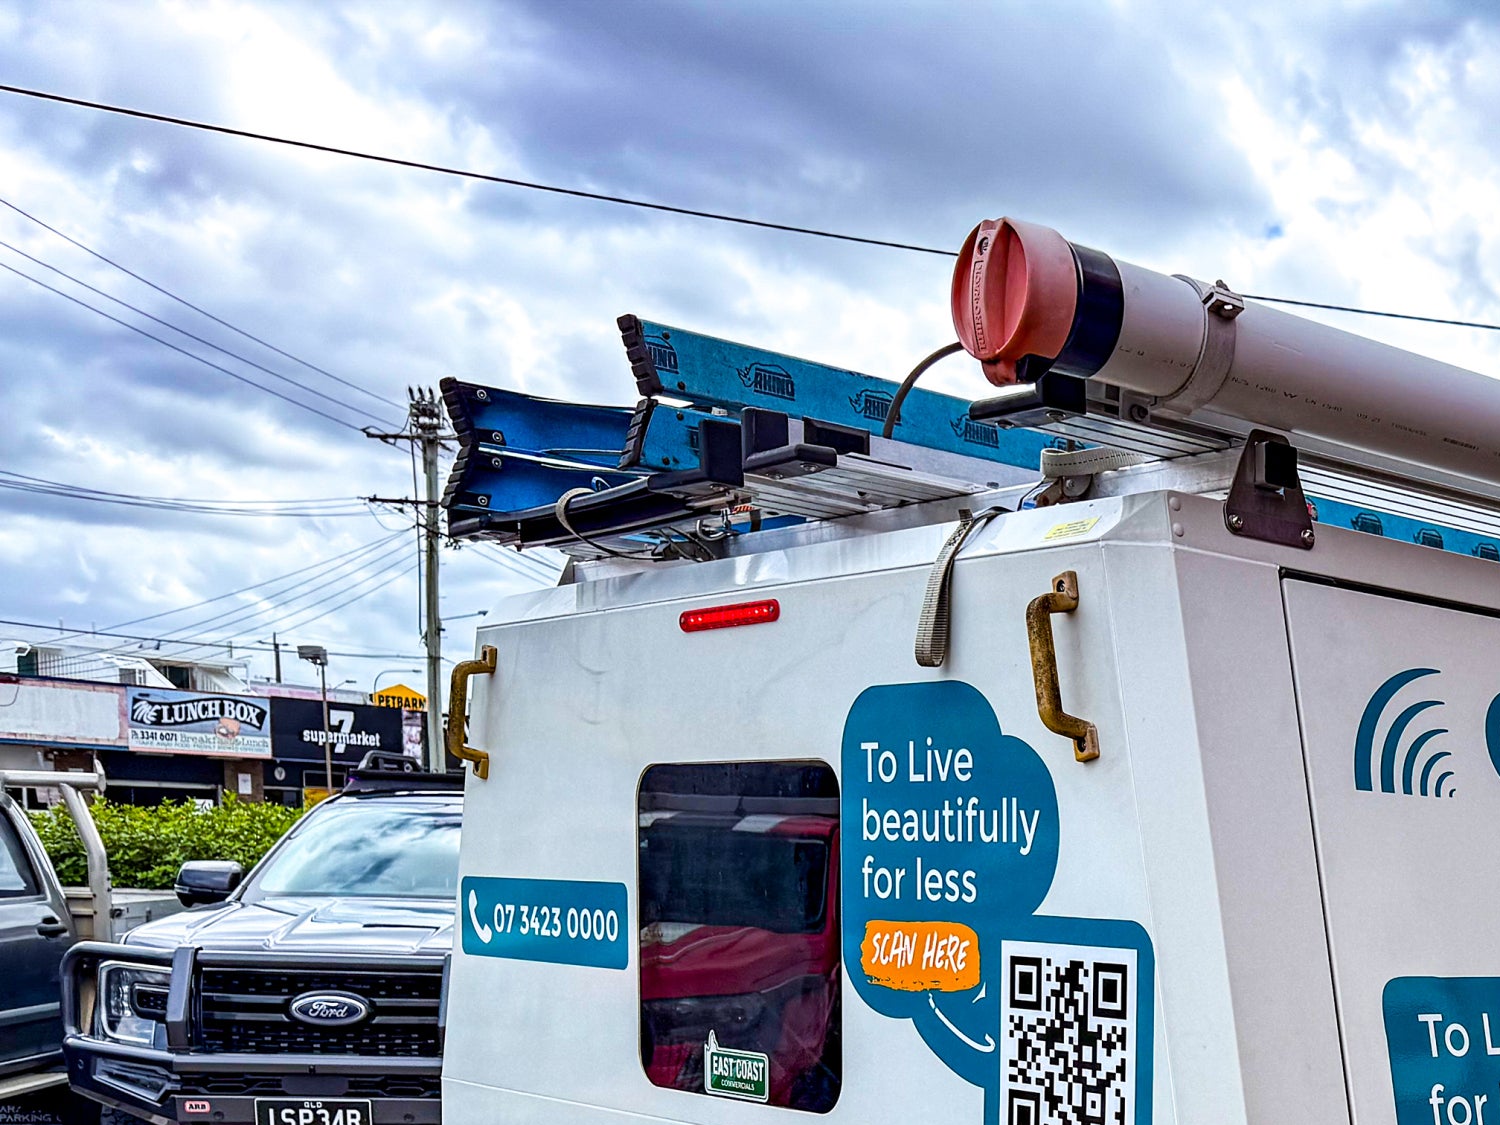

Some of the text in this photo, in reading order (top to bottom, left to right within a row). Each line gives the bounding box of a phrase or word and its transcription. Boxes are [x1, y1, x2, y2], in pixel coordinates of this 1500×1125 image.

[161, 700, 221, 723] LUNCH
[223, 700, 261, 727] BOX
[378, 694, 426, 710] PETBARN
[140, 730, 157, 740] 3341
[302, 729, 381, 747] supermarket
[329, 709, 355, 754] 7
[860, 736, 973, 783] To Live
[862, 797, 1041, 856] beautifully
[862, 855, 977, 903] for less
[493, 903, 619, 942] 07 3423 0000
[871, 930, 971, 974] SCAN HERE
[308, 1001, 348, 1018] Ford
[1418, 1013, 1470, 1059] To
[712, 1055, 764, 1082] EAST COAST
[721, 1079, 755, 1091] COMMERCIALS
[0, 1113, 51, 1122] PARKING
